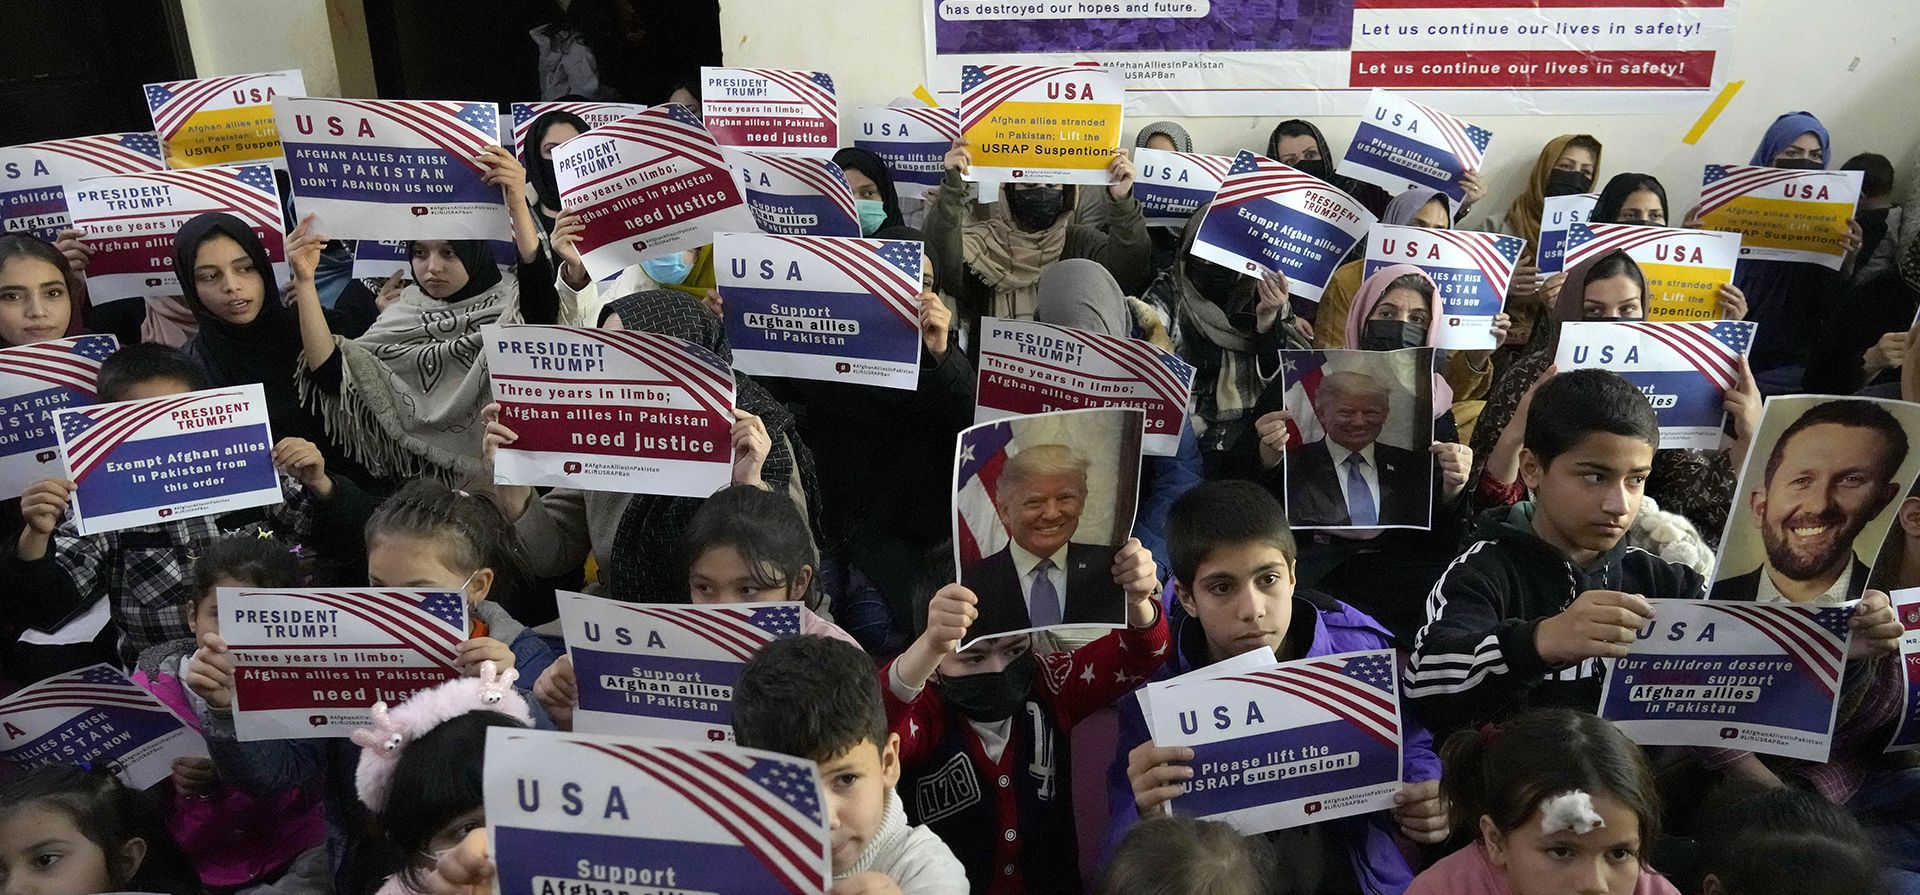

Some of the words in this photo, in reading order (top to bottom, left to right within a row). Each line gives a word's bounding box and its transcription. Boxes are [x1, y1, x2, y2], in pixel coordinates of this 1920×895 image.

[945, 4, 970, 14] has
[975, 1, 1044, 15] destroyed
[1050, 4, 1073, 13] our
[1078, 3, 1120, 15] hopes
[1125, 2, 1149, 12] and
[1154, 2, 1197, 12] future.
[1361, 23, 1391, 36] Let
[1398, 25, 1419, 36] us
[1427, 23, 1510, 36] continue
[1517, 24, 1549, 35] our
[1555, 22, 1600, 35] lives
[1609, 22, 1626, 35] in
[1634, 22, 1701, 36] safety!
[1358, 62, 1387, 74] Let
[1393, 64, 1415, 74] us
[1421, 62, 1501, 74] continue
[1507, 63, 1539, 74] our
[1544, 62, 1589, 74] lives
[1596, 62, 1613, 74] in
[1620, 61, 1685, 76] safety!
[708, 78, 768, 88] PRESIDENT
[725, 87, 767, 96] TRUMP!
[1047, 82, 1094, 101] USA
[232, 87, 277, 105] USA
[707, 105, 732, 113] Three
[735, 106, 760, 115] years
[775, 106, 804, 114] limbo;
[295, 114, 376, 138] USA
[709, 119, 742, 127] Afghan
[745, 119, 771, 127] allies
[991, 116, 1027, 126] Afghan
[1030, 117, 1058, 126] allies
[1061, 117, 1105, 127] stranded
[1375, 106, 1418, 134] USA
[746, 132, 777, 142] need
[782, 132, 828, 144] justice
[863, 122, 909, 137] USA
[296, 149, 347, 160] AFGHAN
[352, 151, 395, 163] ALLIES
[399, 154, 413, 164] AT
[418, 155, 448, 165] RISK
[559, 140, 619, 172] PRESIDENT
[981, 143, 1030, 154] USRAP
[308, 162, 329, 173] IN
[343, 164, 445, 179] PAKISTAN
[575, 152, 622, 178] TRUMP!
[1143, 165, 1189, 182] USA
[77, 184, 171, 202] PRESIDENT
[300, 177, 337, 188] DON'T
[342, 179, 400, 193] ABANDON
[405, 183, 422, 193] US
[426, 184, 454, 194] NOW
[564, 193, 590, 208] Three
[591, 182, 622, 199] years
[625, 177, 637, 188] in
[639, 164, 678, 184] limbo;
[612, 195, 645, 212] allies
[647, 190, 659, 201] in
[662, 172, 714, 195] Pakistan
[1783, 184, 1829, 200] USA
[107, 197, 173, 211] TRUMP!
[1146, 193, 1179, 205] Please
[1304, 190, 1361, 225] PRESIDENT
[624, 205, 664, 230] need
[667, 189, 727, 220] justice
[1303, 200, 1342, 224] TRUMP!
[10, 215, 65, 229] Afghan
[90, 240, 140, 252] Afghan
[1382, 238, 1441, 260] USA
[1655, 244, 1703, 264] USA
[731, 258, 803, 282] USA
[770, 303, 831, 319] Support
[748, 314, 804, 332] Afghan
[809, 319, 856, 334] allies
[765, 329, 779, 341] in
[783, 331, 845, 346] Pakistan
[992, 329, 1085, 353] PRESIDENT
[498, 340, 605, 358] PRESIDENT
[1018, 343, 1082, 367] TRUMP!
[1573, 345, 1640, 364] USA
[530, 354, 605, 372] TRUMP!
[987, 357, 1025, 375] Three
[1029, 368, 1066, 385] years
[1071, 377, 1084, 388] in
[1090, 381, 1135, 395] limbo;
[34, 392, 70, 407] RISK
[499, 382, 543, 400] Three
[549, 386, 594, 404] years
[599, 387, 614, 401] in
[620, 388, 672, 404] limbo;
[988, 375, 1036, 393] Afghan
[1041, 386, 1079, 404] allies
[1084, 397, 1098, 408] in
[171, 402, 251, 421] PRESIDENT
[505, 405, 560, 423] Afghan
[566, 408, 612, 423] allies
[618, 409, 634, 423] in
[639, 410, 709, 428] Pakistan
[176, 415, 234, 431] TRUMP!
[571, 428, 626, 448] need
[634, 431, 715, 455] justice
[106, 455, 163, 473] Exempt
[167, 447, 220, 466] Afghan
[224, 441, 266, 455] allies
[132, 473, 146, 484] in
[151, 462, 212, 481] Pakistan
[216, 458, 248, 471] from
[163, 481, 189, 493] this
[192, 475, 226, 489] order
[235, 610, 338, 624] PRESIDENT
[264, 624, 338, 639] TRUMP!
[584, 620, 666, 650] USA
[1636, 621, 1716, 643] USA
[234, 651, 278, 663] Three
[284, 652, 330, 666] years
[334, 651, 349, 663] in
[354, 651, 405, 665] limbo;
[1617, 657, 1647, 670] Our
[1652, 659, 1722, 671] children
[1728, 659, 1793, 671] deserve
[244, 668, 298, 684] Afghan
[305, 669, 350, 681] allies
[355, 669, 371, 681] in
[376, 669, 445, 682] Pakistan
[632, 667, 702, 684] Support
[1624, 674, 1633, 684] a
[1707, 674, 1774, 687] support
[313, 688, 367, 702] need
[606, 675, 671, 695] Afghan
[678, 682, 732, 699] allies
[1633, 687, 1697, 700] Afghan
[1702, 687, 1755, 699] allies
[625, 691, 641, 705] in
[646, 694, 719, 712] Pakistan
[1645, 702, 1659, 713] in
[1665, 702, 1737, 714] Pakistan
[1179, 700, 1265, 735] USA
[1201, 756, 1261, 775] Please
[1266, 750, 1296, 767] lift
[1301, 743, 1330, 758] the
[1183, 773, 1241, 793] USRAP
[1247, 754, 1355, 782] suspension!
[517, 778, 630, 821] USA
[577, 858, 676, 888] Support
